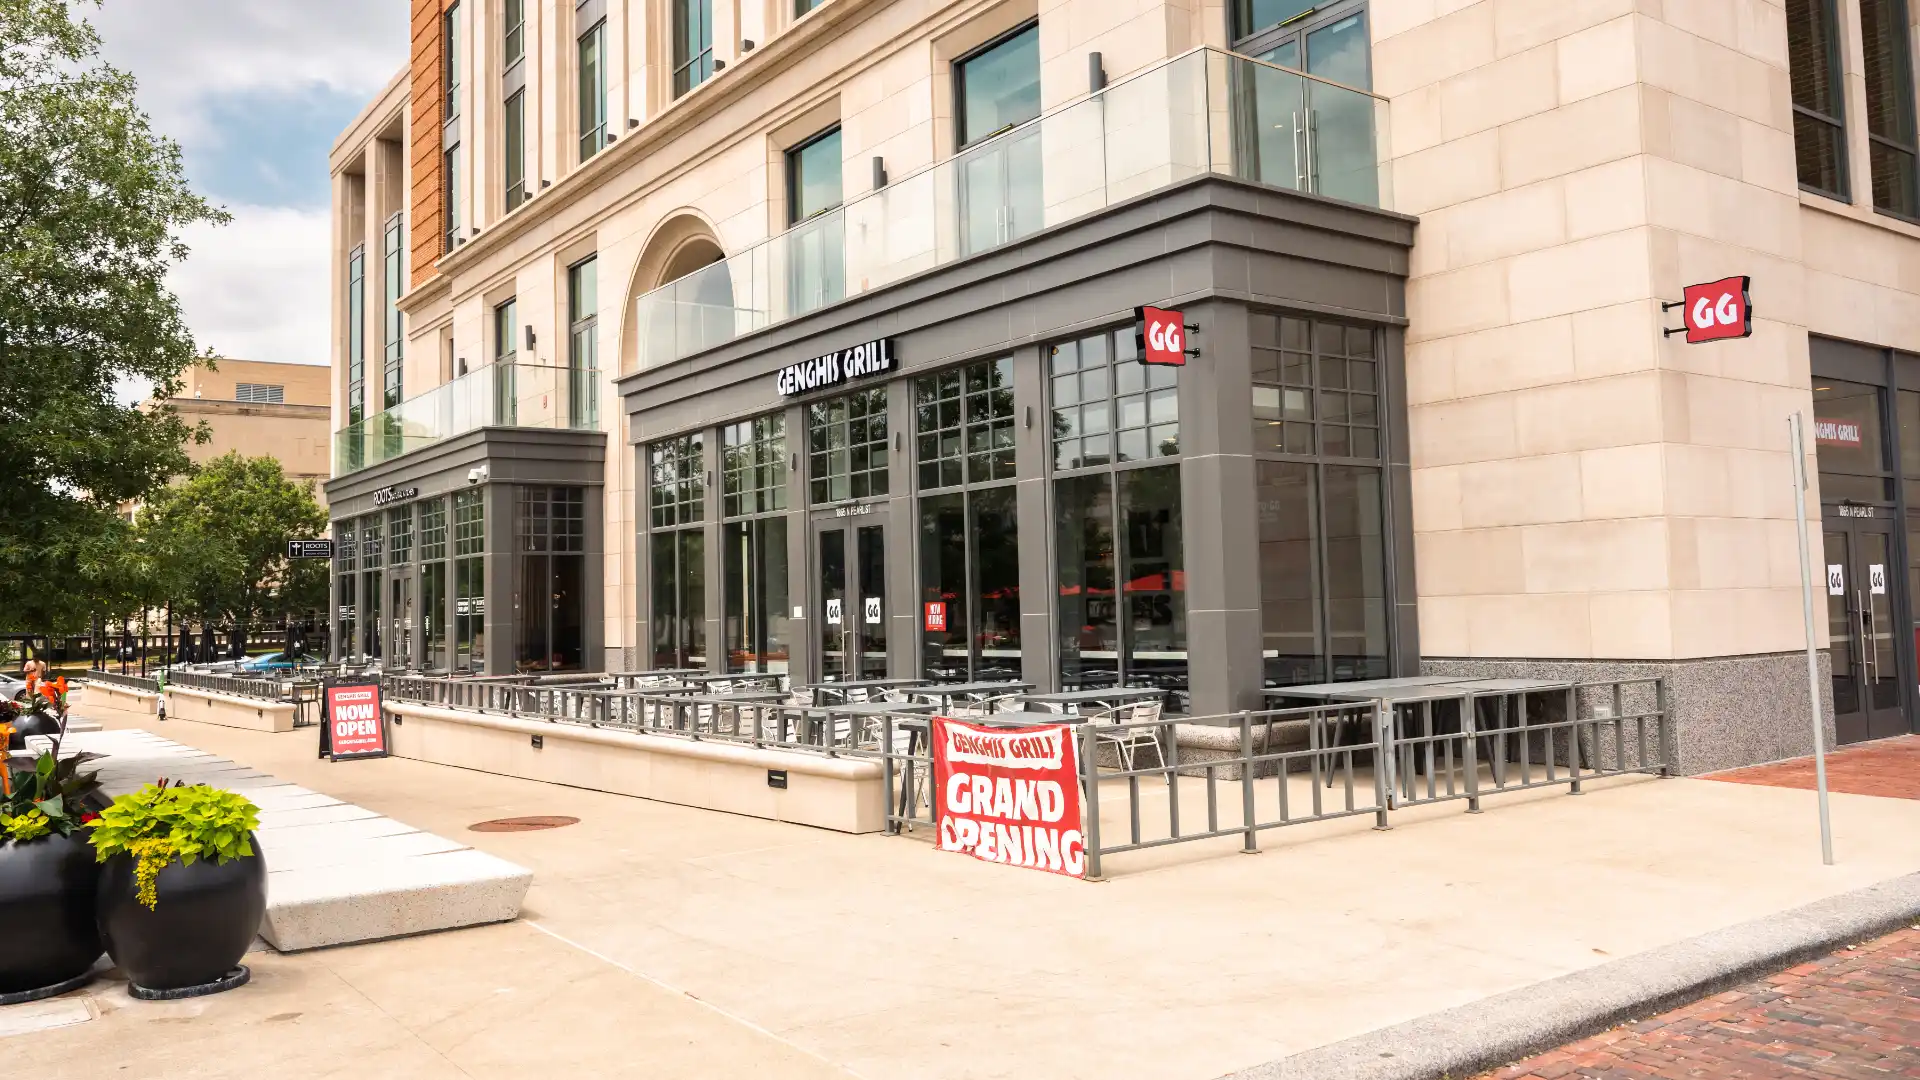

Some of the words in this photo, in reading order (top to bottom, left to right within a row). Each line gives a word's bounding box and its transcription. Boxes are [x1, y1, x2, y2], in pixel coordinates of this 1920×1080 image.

[1692, 292, 1738, 329] GG
[1149, 320, 1180, 353] GG
[777, 352, 840, 396] GENGHIS
[843, 339, 890, 379] GRILL
[1815, 422, 1837, 440] NGHIS
[1837, 424, 1860, 442] GRILL
[373, 486, 392, 506] ROOTS
[865, 504, 871, 514] ST
[1853, 506, 1868, 518] PEARL
[1867, 506, 1874, 518] ST
[1830, 572, 1842, 588] GG
[1872, 571, 1883, 588] GG
[829, 604, 839, 619] GG
[868, 603, 879, 618] GG
[336, 704, 374, 721] NOW
[336, 720, 377, 737] OPEN
[953, 731, 1005, 760] GENGHIS
[1009, 736, 1056, 760] GRILL
[946, 772, 1065, 823] GRAND
[940, 815, 1085, 876] OPENING
